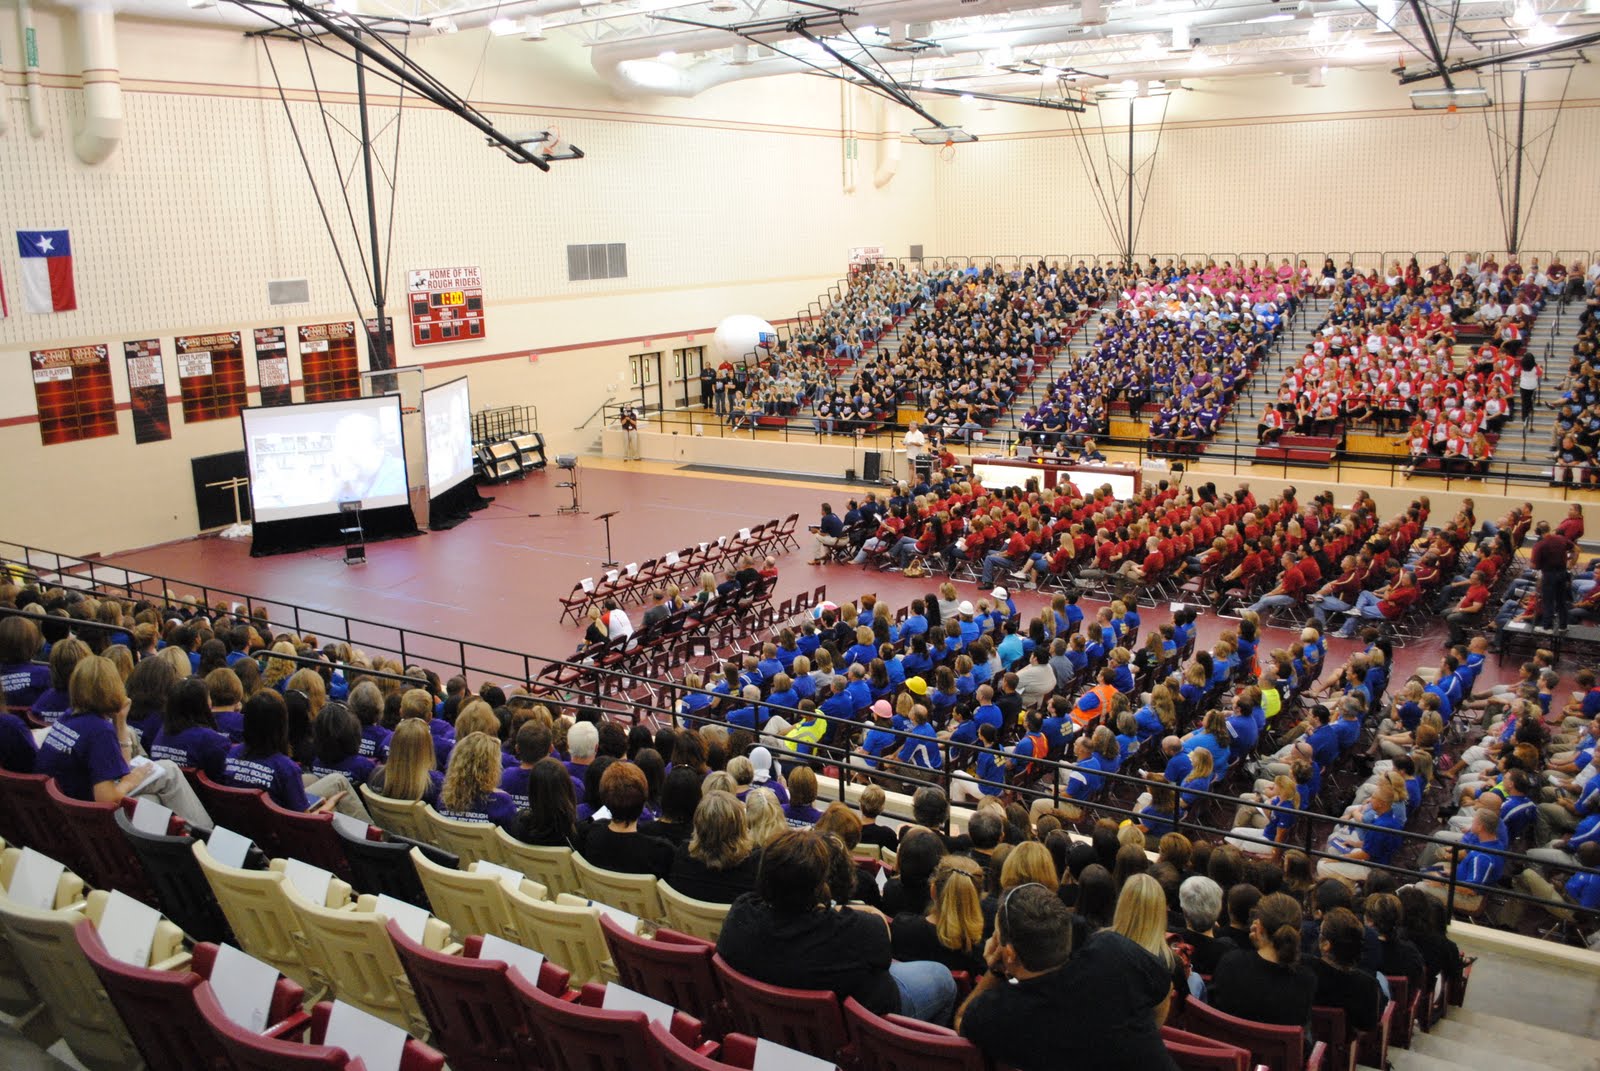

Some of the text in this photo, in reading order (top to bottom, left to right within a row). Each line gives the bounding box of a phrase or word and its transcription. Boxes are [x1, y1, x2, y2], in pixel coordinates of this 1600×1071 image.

[429, 267, 478, 279] HOME OF THE
[427, 277, 481, 289] ROUGH RIDERS
[35, 369, 49, 378] STATE
[361, 738, 376, 746] OUGH
[249, 761, 275, 774] ENOUGH
[234, 772, 271, 789] 2010-2011
[250, 769, 274, 781] BOUND
[465, 811, 489, 819] ENOUGH
